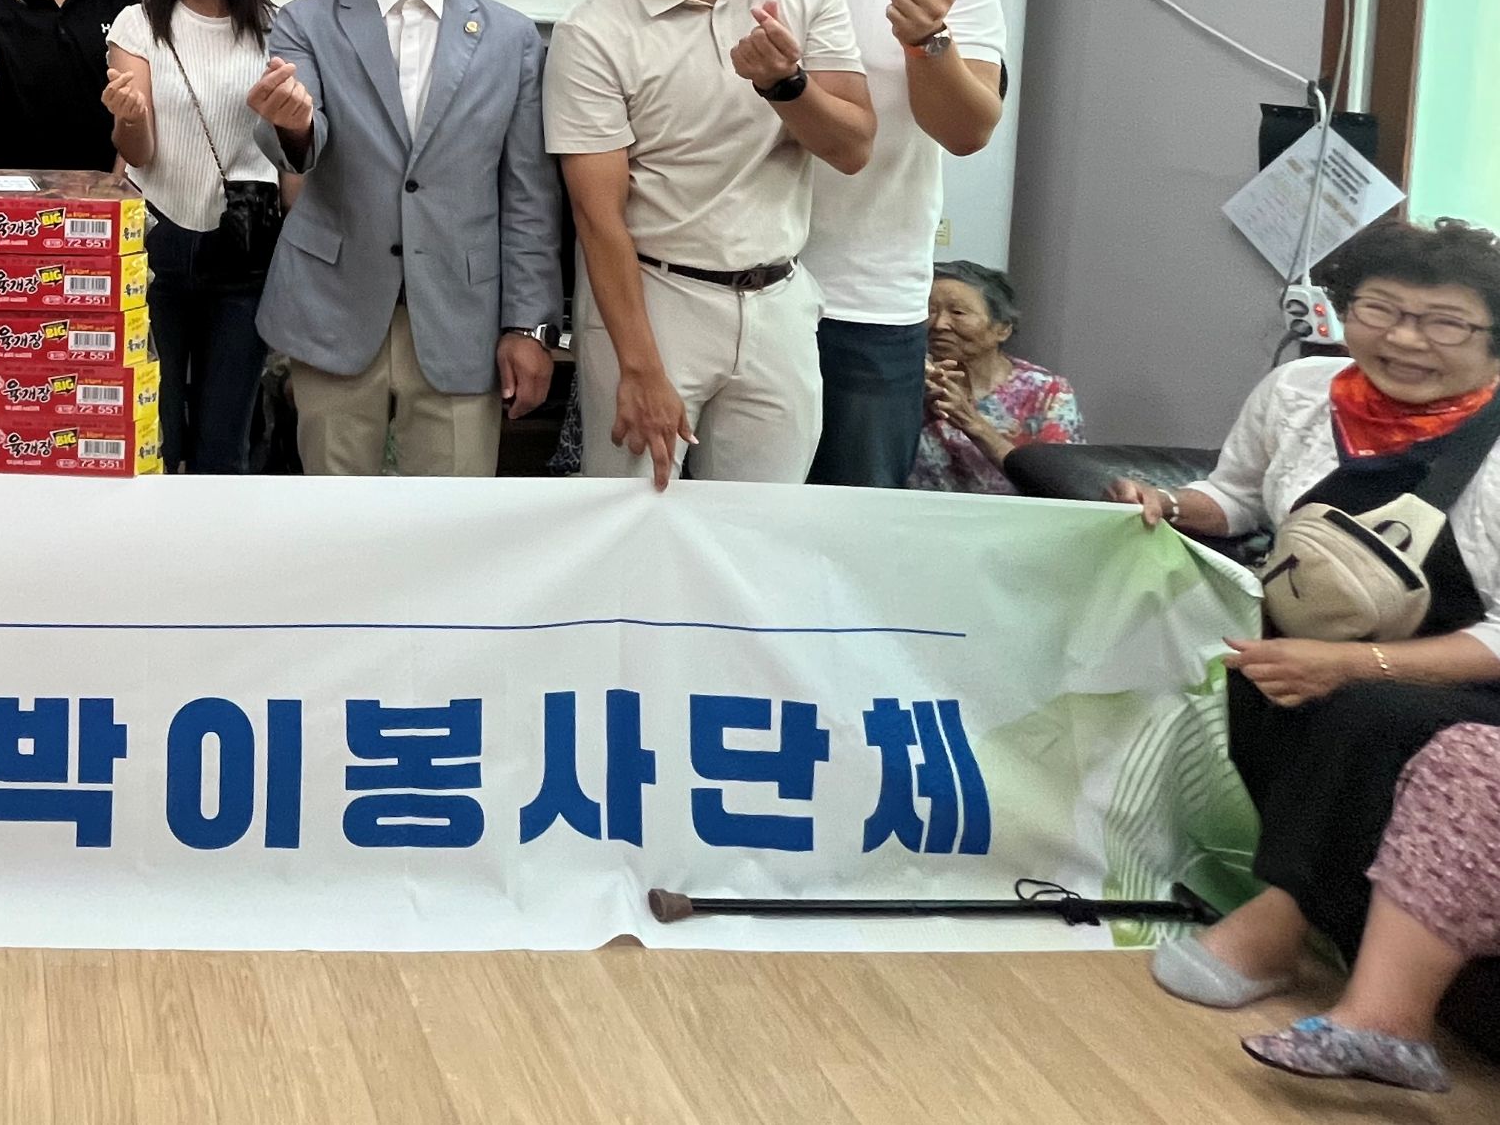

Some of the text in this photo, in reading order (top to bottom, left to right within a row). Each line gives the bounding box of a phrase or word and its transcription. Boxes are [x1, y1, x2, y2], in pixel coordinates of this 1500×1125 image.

[41, 211, 62, 225] BIG
[67, 238, 108, 248] 72 551
[41, 268, 62, 282] BIG
[66, 295, 107, 305] 72 551
[45, 324, 66, 338] BIG
[71, 351, 112, 361] 72 551
[3, 377, 75, 402] 육개장 BIG
[79, 405, 120, 415] 72 551
[4, 431, 76, 457] 육개장 BIG
[80, 459, 121, 469] 72 551
